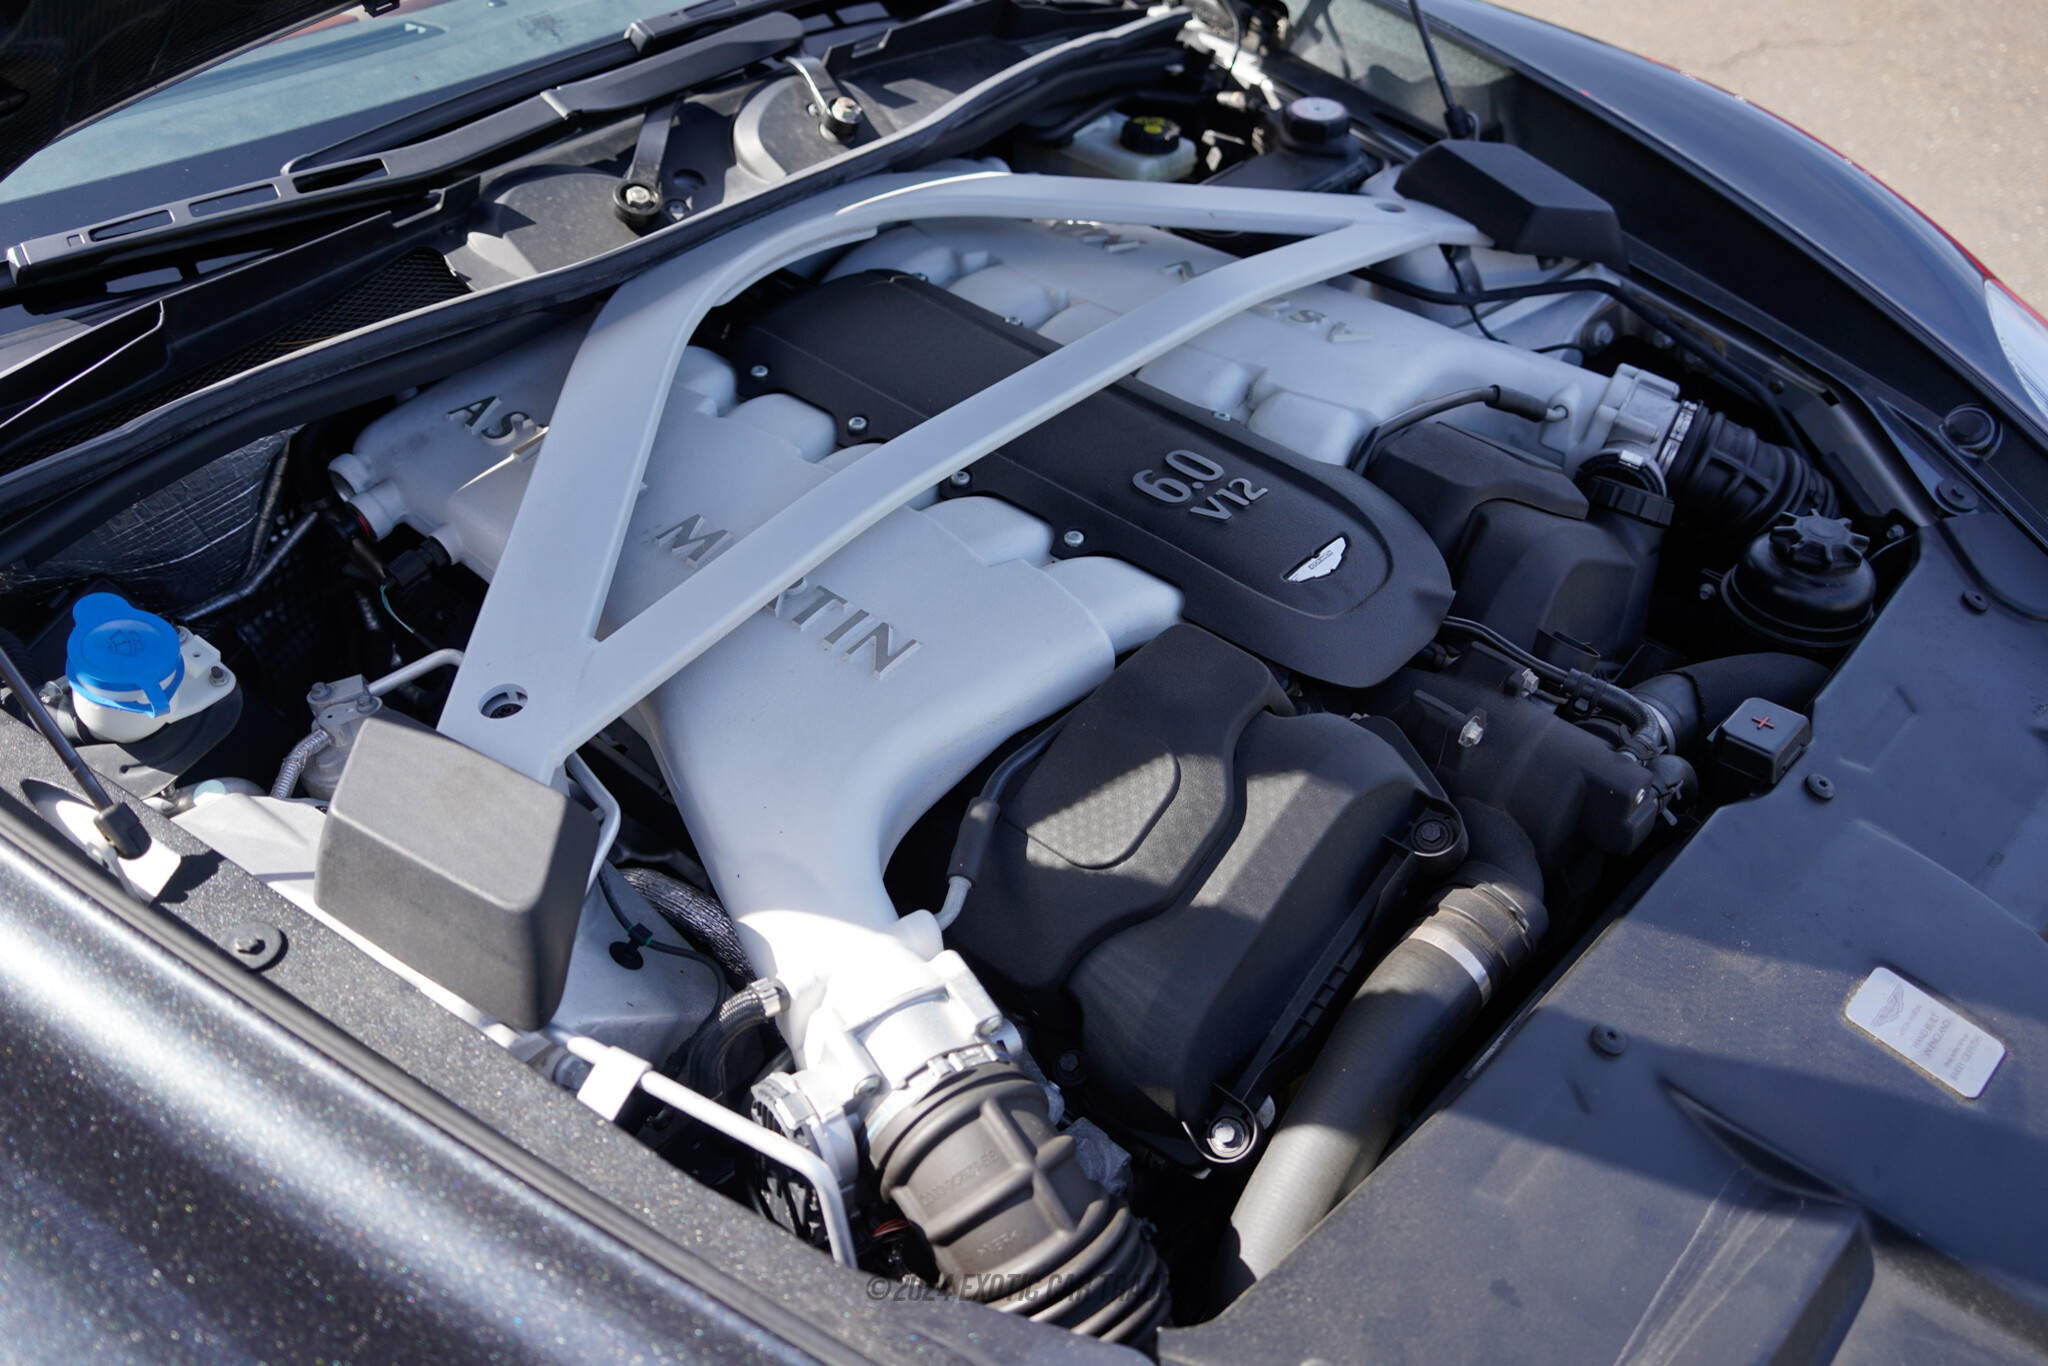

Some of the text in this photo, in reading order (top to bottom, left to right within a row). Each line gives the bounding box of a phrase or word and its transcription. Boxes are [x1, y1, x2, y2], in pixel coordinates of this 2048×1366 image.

[1132, 449, 1225, 504] 6.0
[1188, 477, 1269, 522] V12
[1911, 1011, 1940, 1049] HAND BUILT
[1926, 1018, 1952, 1050] ENGLAND
